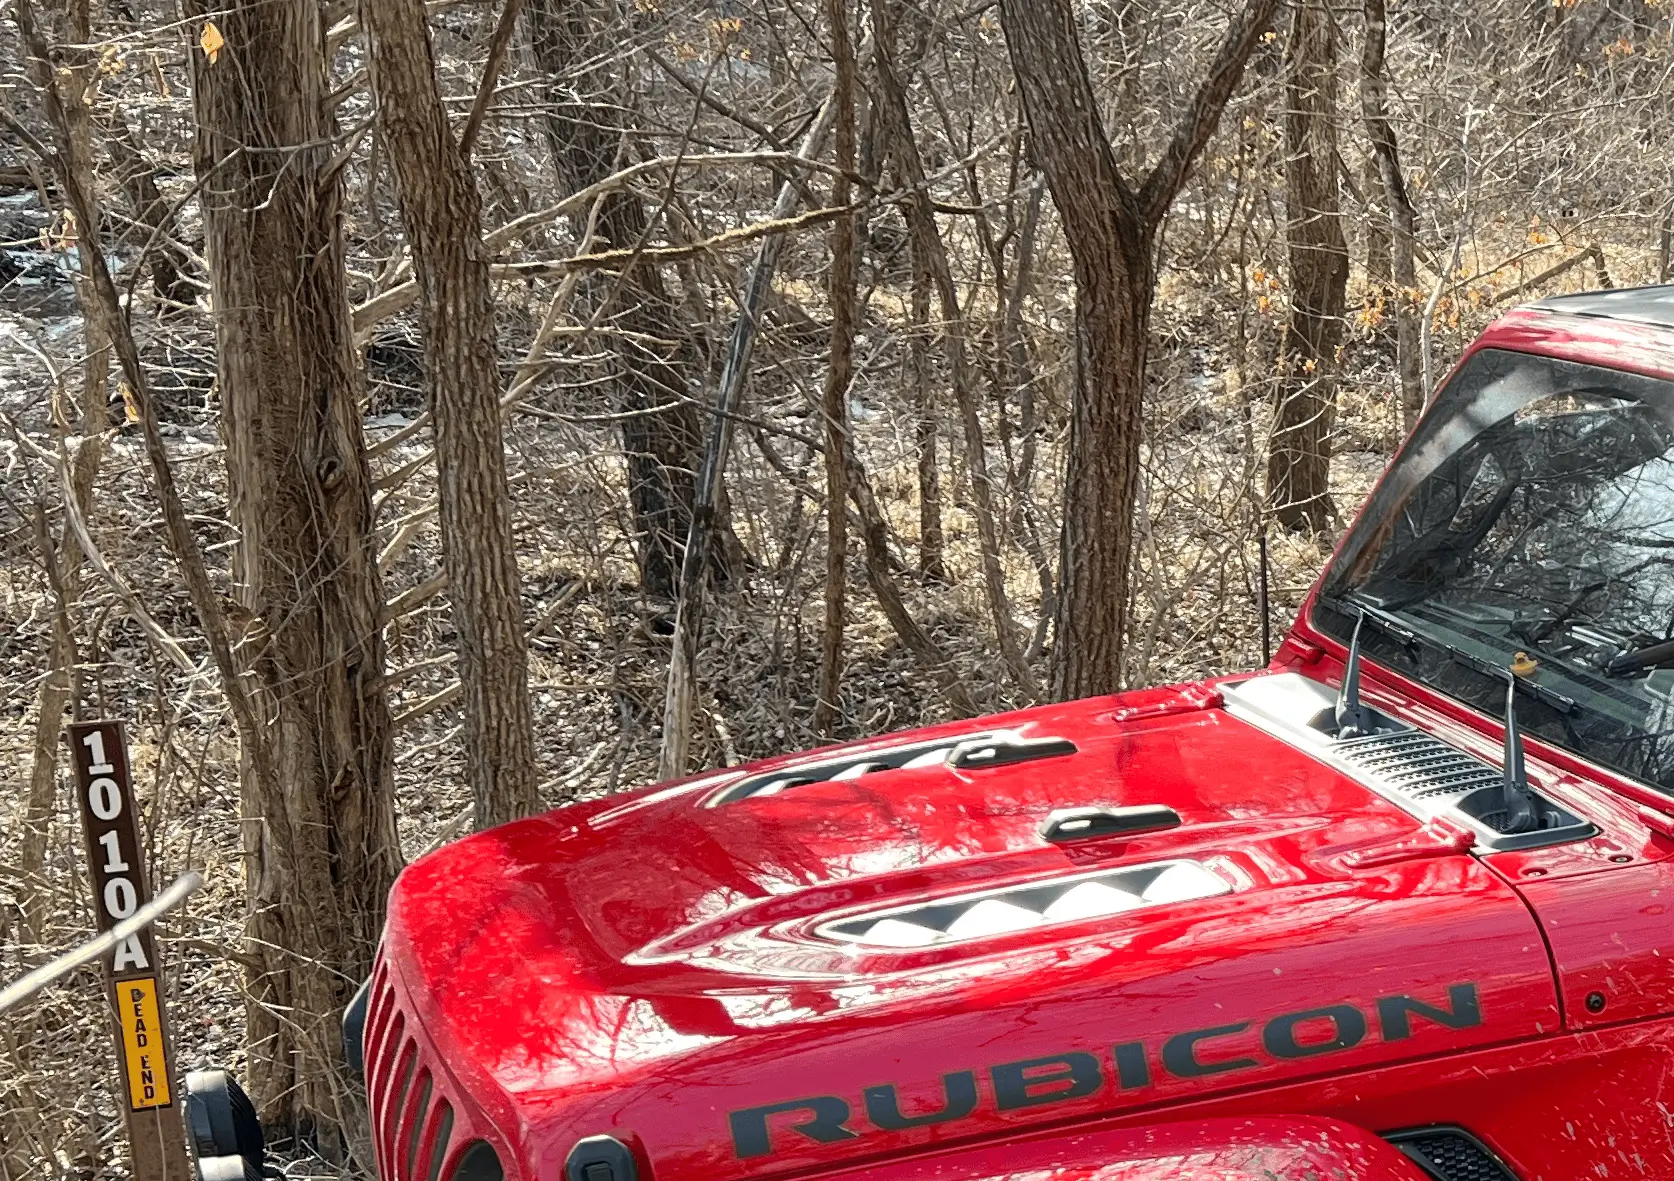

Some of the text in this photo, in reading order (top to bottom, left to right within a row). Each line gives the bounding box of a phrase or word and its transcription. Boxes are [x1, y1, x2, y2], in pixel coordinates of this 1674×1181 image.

[83, 730, 149, 972] 1010A
[130, 988, 155, 1099] DEAD END
[729, 982, 1485, 1160] RUBICON
